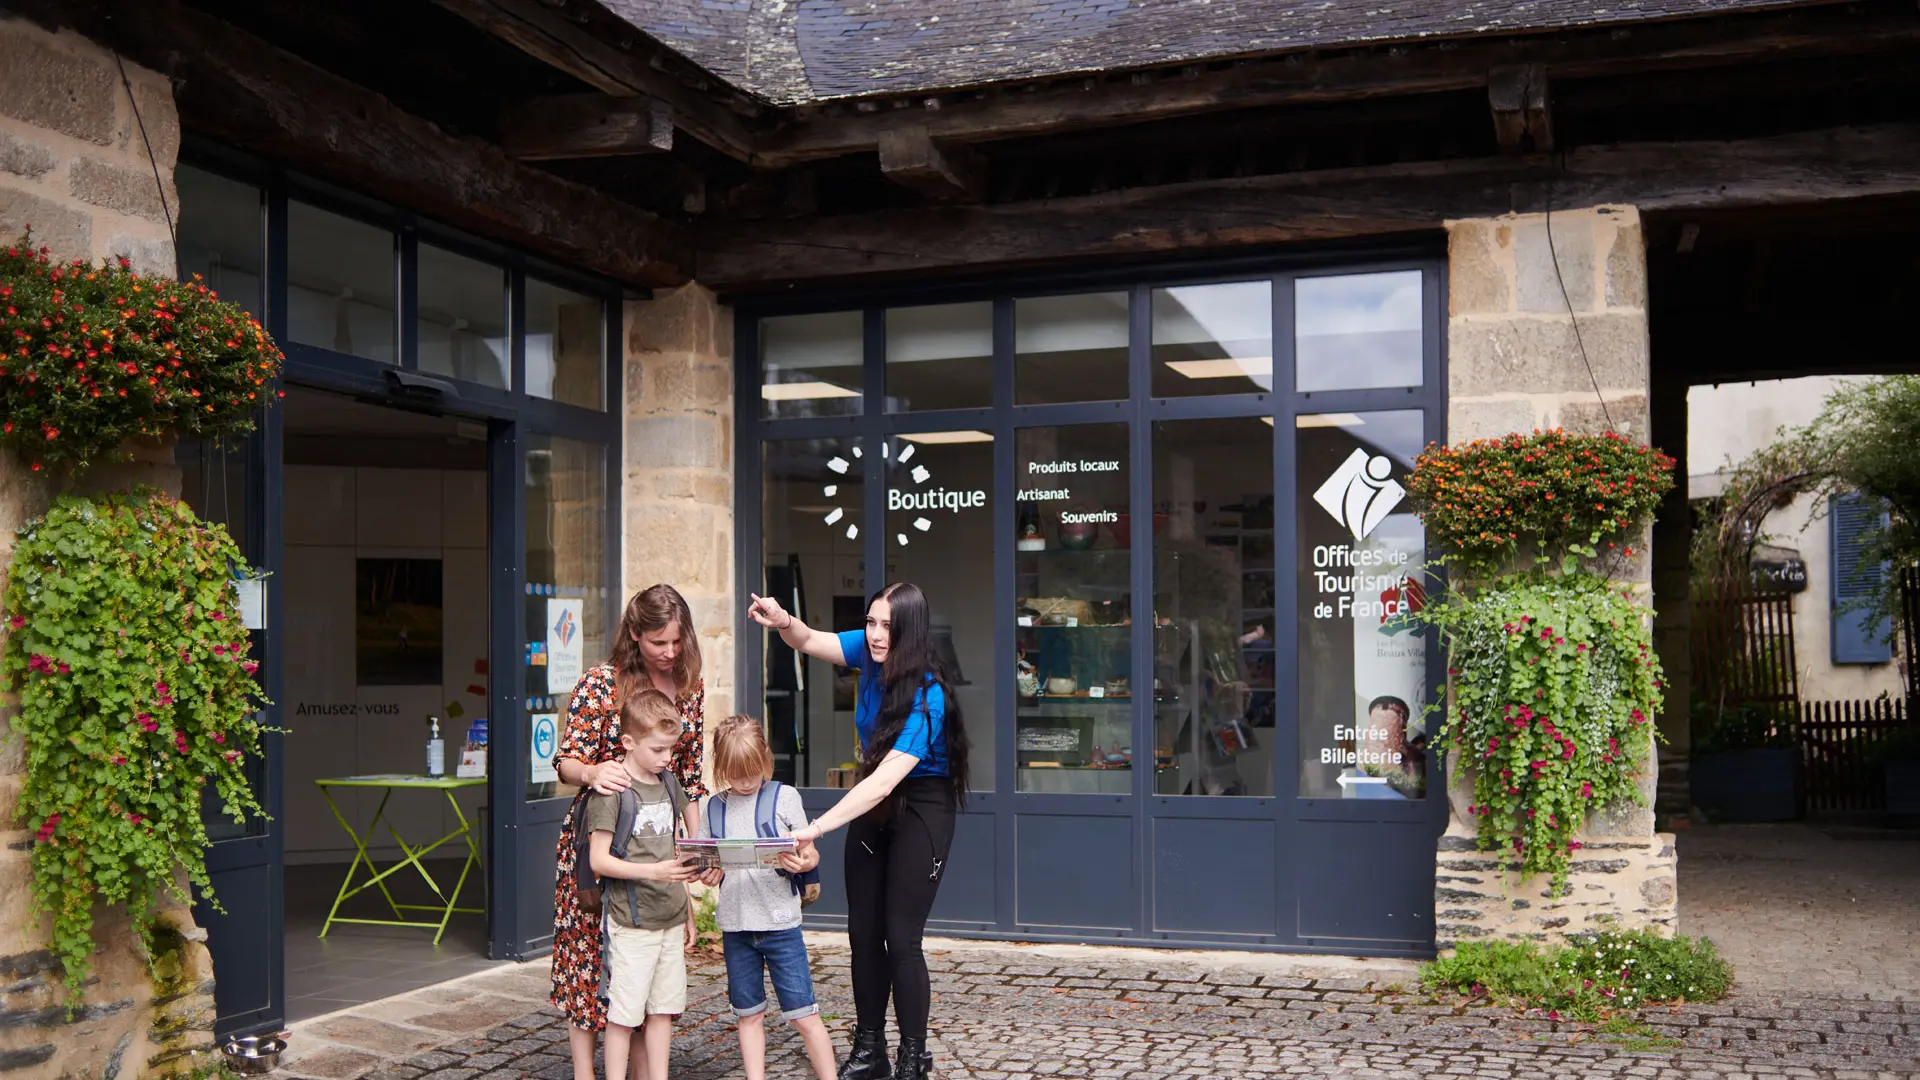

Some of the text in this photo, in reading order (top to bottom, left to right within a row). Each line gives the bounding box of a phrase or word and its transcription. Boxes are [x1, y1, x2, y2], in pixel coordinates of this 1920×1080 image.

[1028, 460, 1119, 474] Produits locaux
[888, 487, 986, 513] Boutique
[1016, 488, 1070, 501] Artisanat
[1061, 510, 1118, 524] Souvenirs
[1313, 545, 1408, 567] Offices de
[1313, 570, 1408, 593] Tourisme
[1314, 596, 1409, 618] de France
[1333, 724, 1389, 741] Entrée
[1320, 747, 1402, 764] Billetterie
